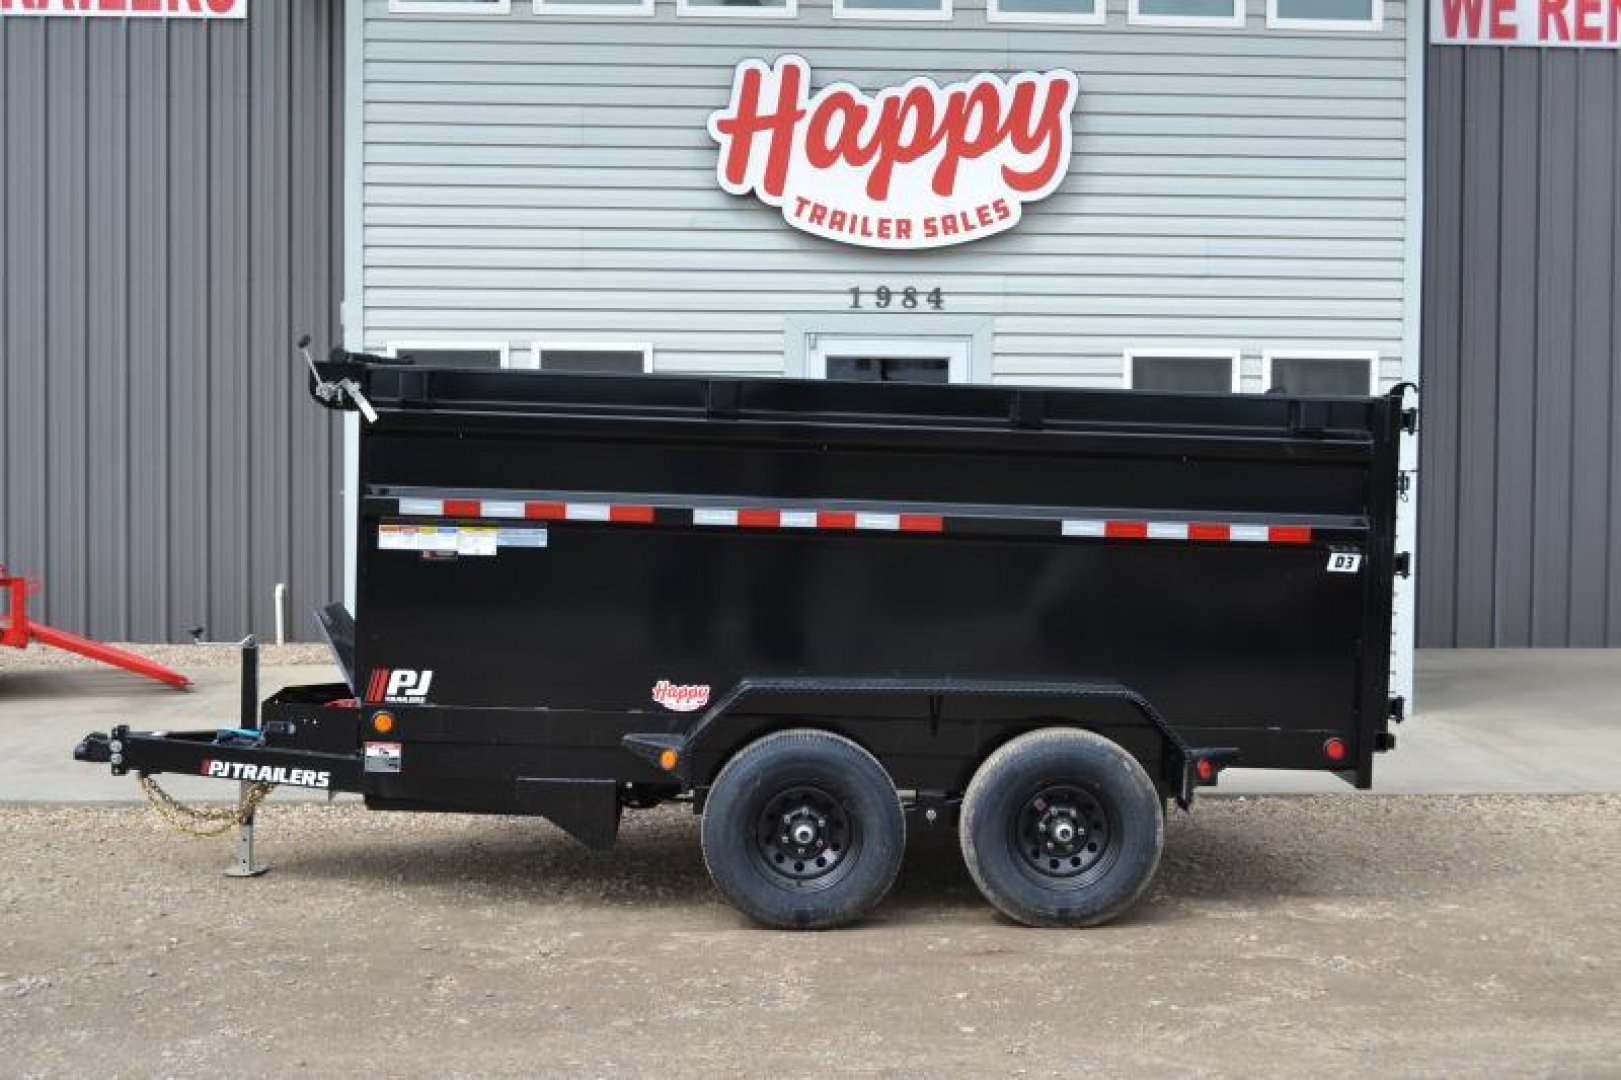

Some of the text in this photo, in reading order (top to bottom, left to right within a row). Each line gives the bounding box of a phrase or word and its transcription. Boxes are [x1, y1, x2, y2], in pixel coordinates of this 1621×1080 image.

[716, 64, 1070, 201] Happy
[794, 196, 1010, 239] TRAILER SALES
[848, 285, 945, 310] 1984
[386, 669, 433, 695] PJ
[208, 760, 330, 787] PJ TRAILERS
